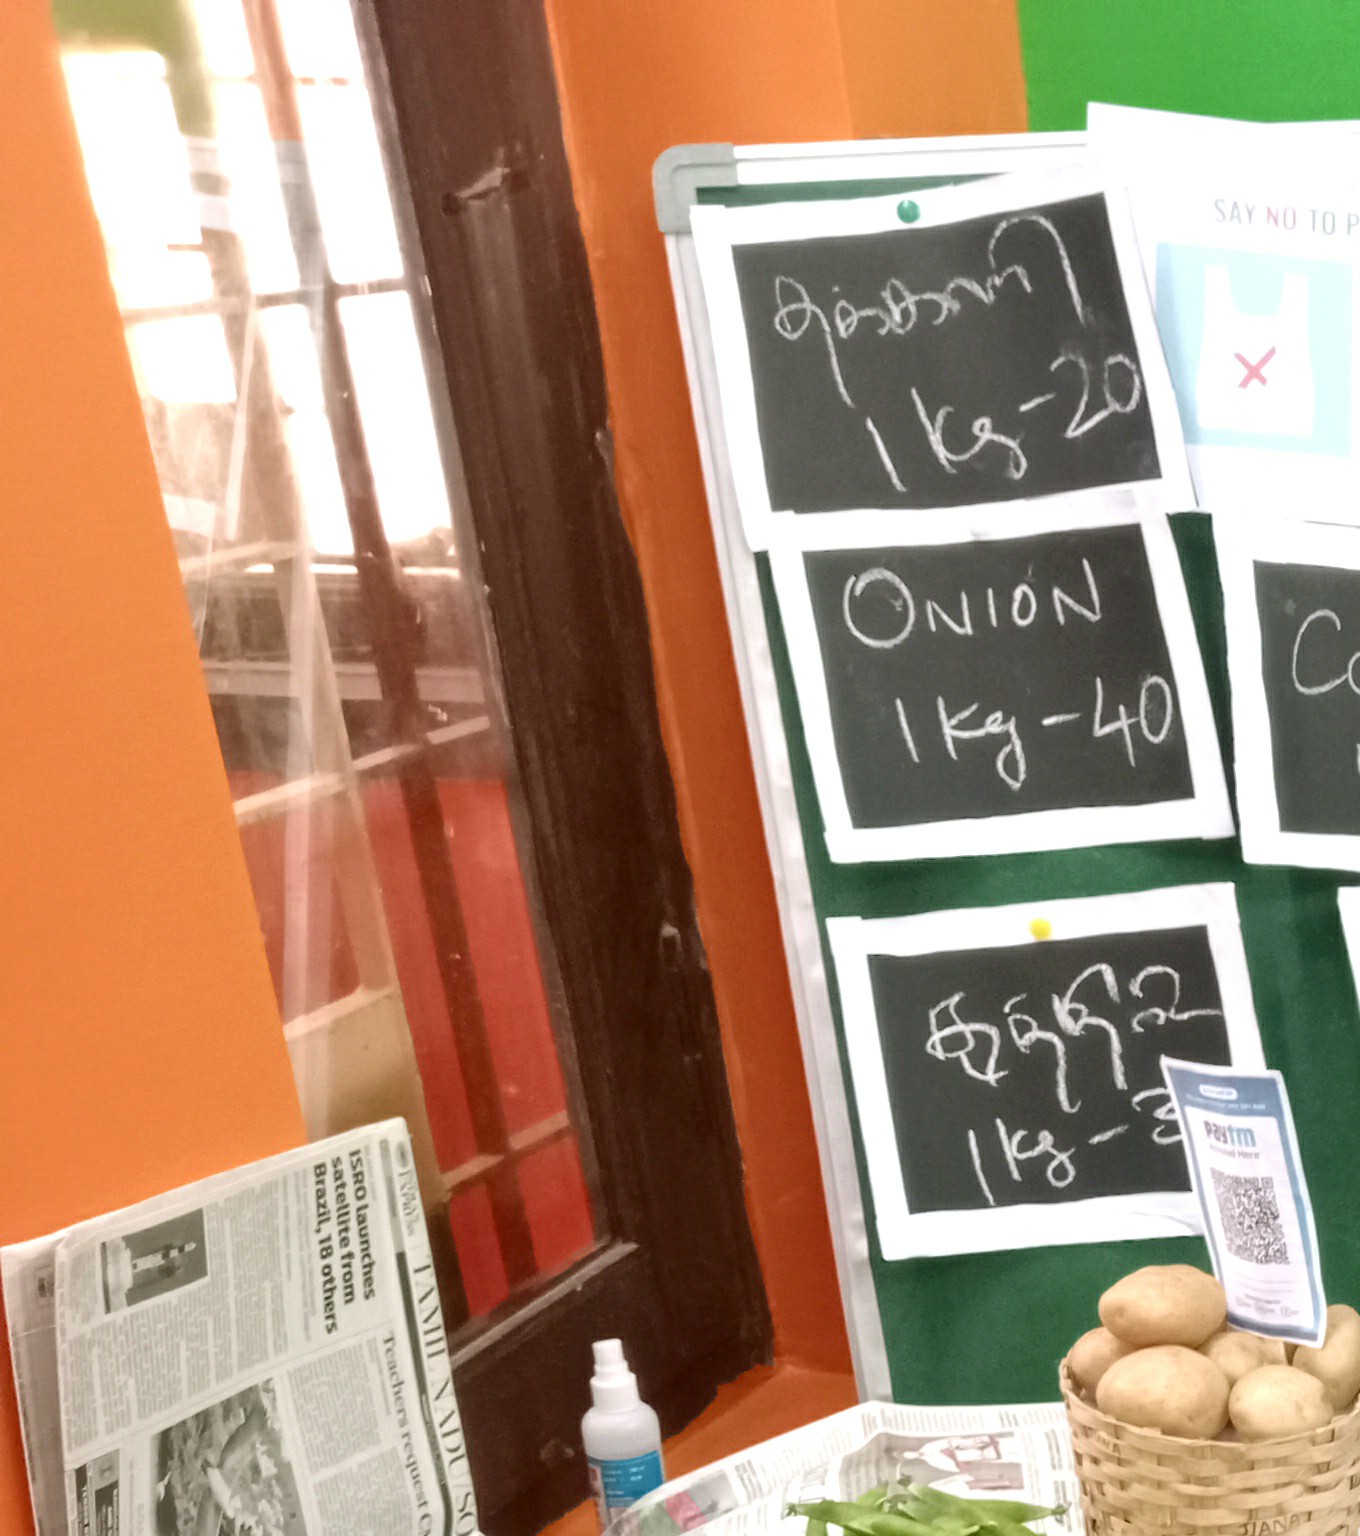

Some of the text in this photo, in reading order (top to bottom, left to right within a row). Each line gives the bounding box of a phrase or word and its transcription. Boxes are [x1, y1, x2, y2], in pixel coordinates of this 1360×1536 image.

[1214, 199, 1255, 225] SAY
[1266, 206, 1297, 230] NO
[1310, 209, 1336, 236] TO
[843, 557, 1102, 649] ONION
[312, 1161, 340, 1336] Brazil, 18 others
[331, 1156, 357, 1305] satellite from
[348, 1149, 376, 1302] ISRO launches
[382, 1333, 412, 1428] Teachers
[400, 1432, 430, 1509] request
